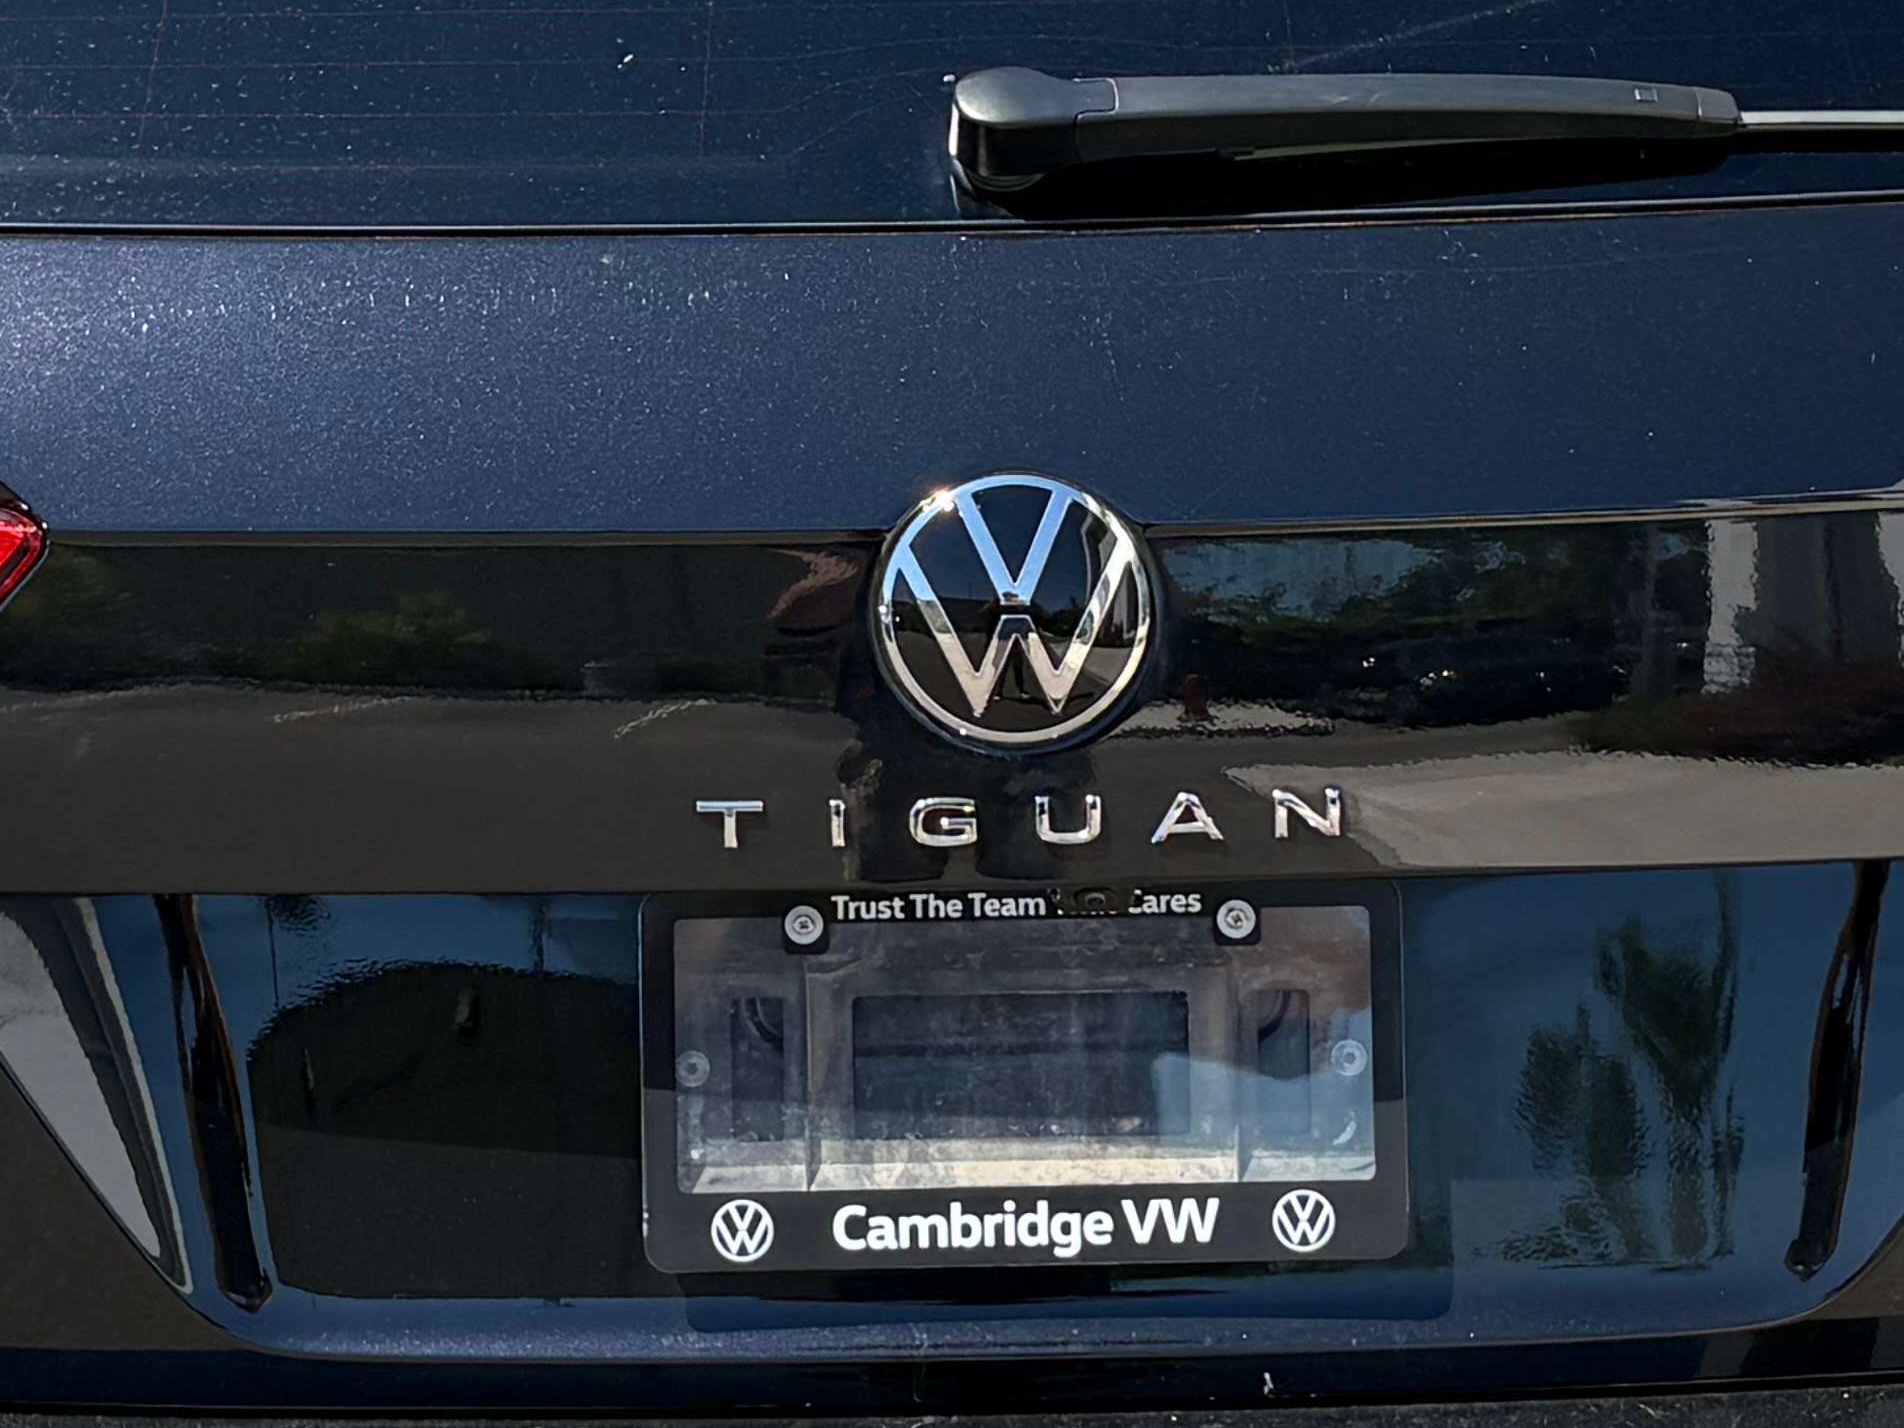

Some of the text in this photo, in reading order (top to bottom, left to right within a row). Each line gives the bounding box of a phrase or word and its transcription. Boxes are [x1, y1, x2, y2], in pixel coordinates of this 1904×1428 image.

[696, 788, 1340, 848] TIGUAN
[830, 894, 904, 921] Trust
[909, 893, 964, 918] The
[968, 891, 1046, 917] Team
[831, 1197, 1219, 1258] Cambridge VW
